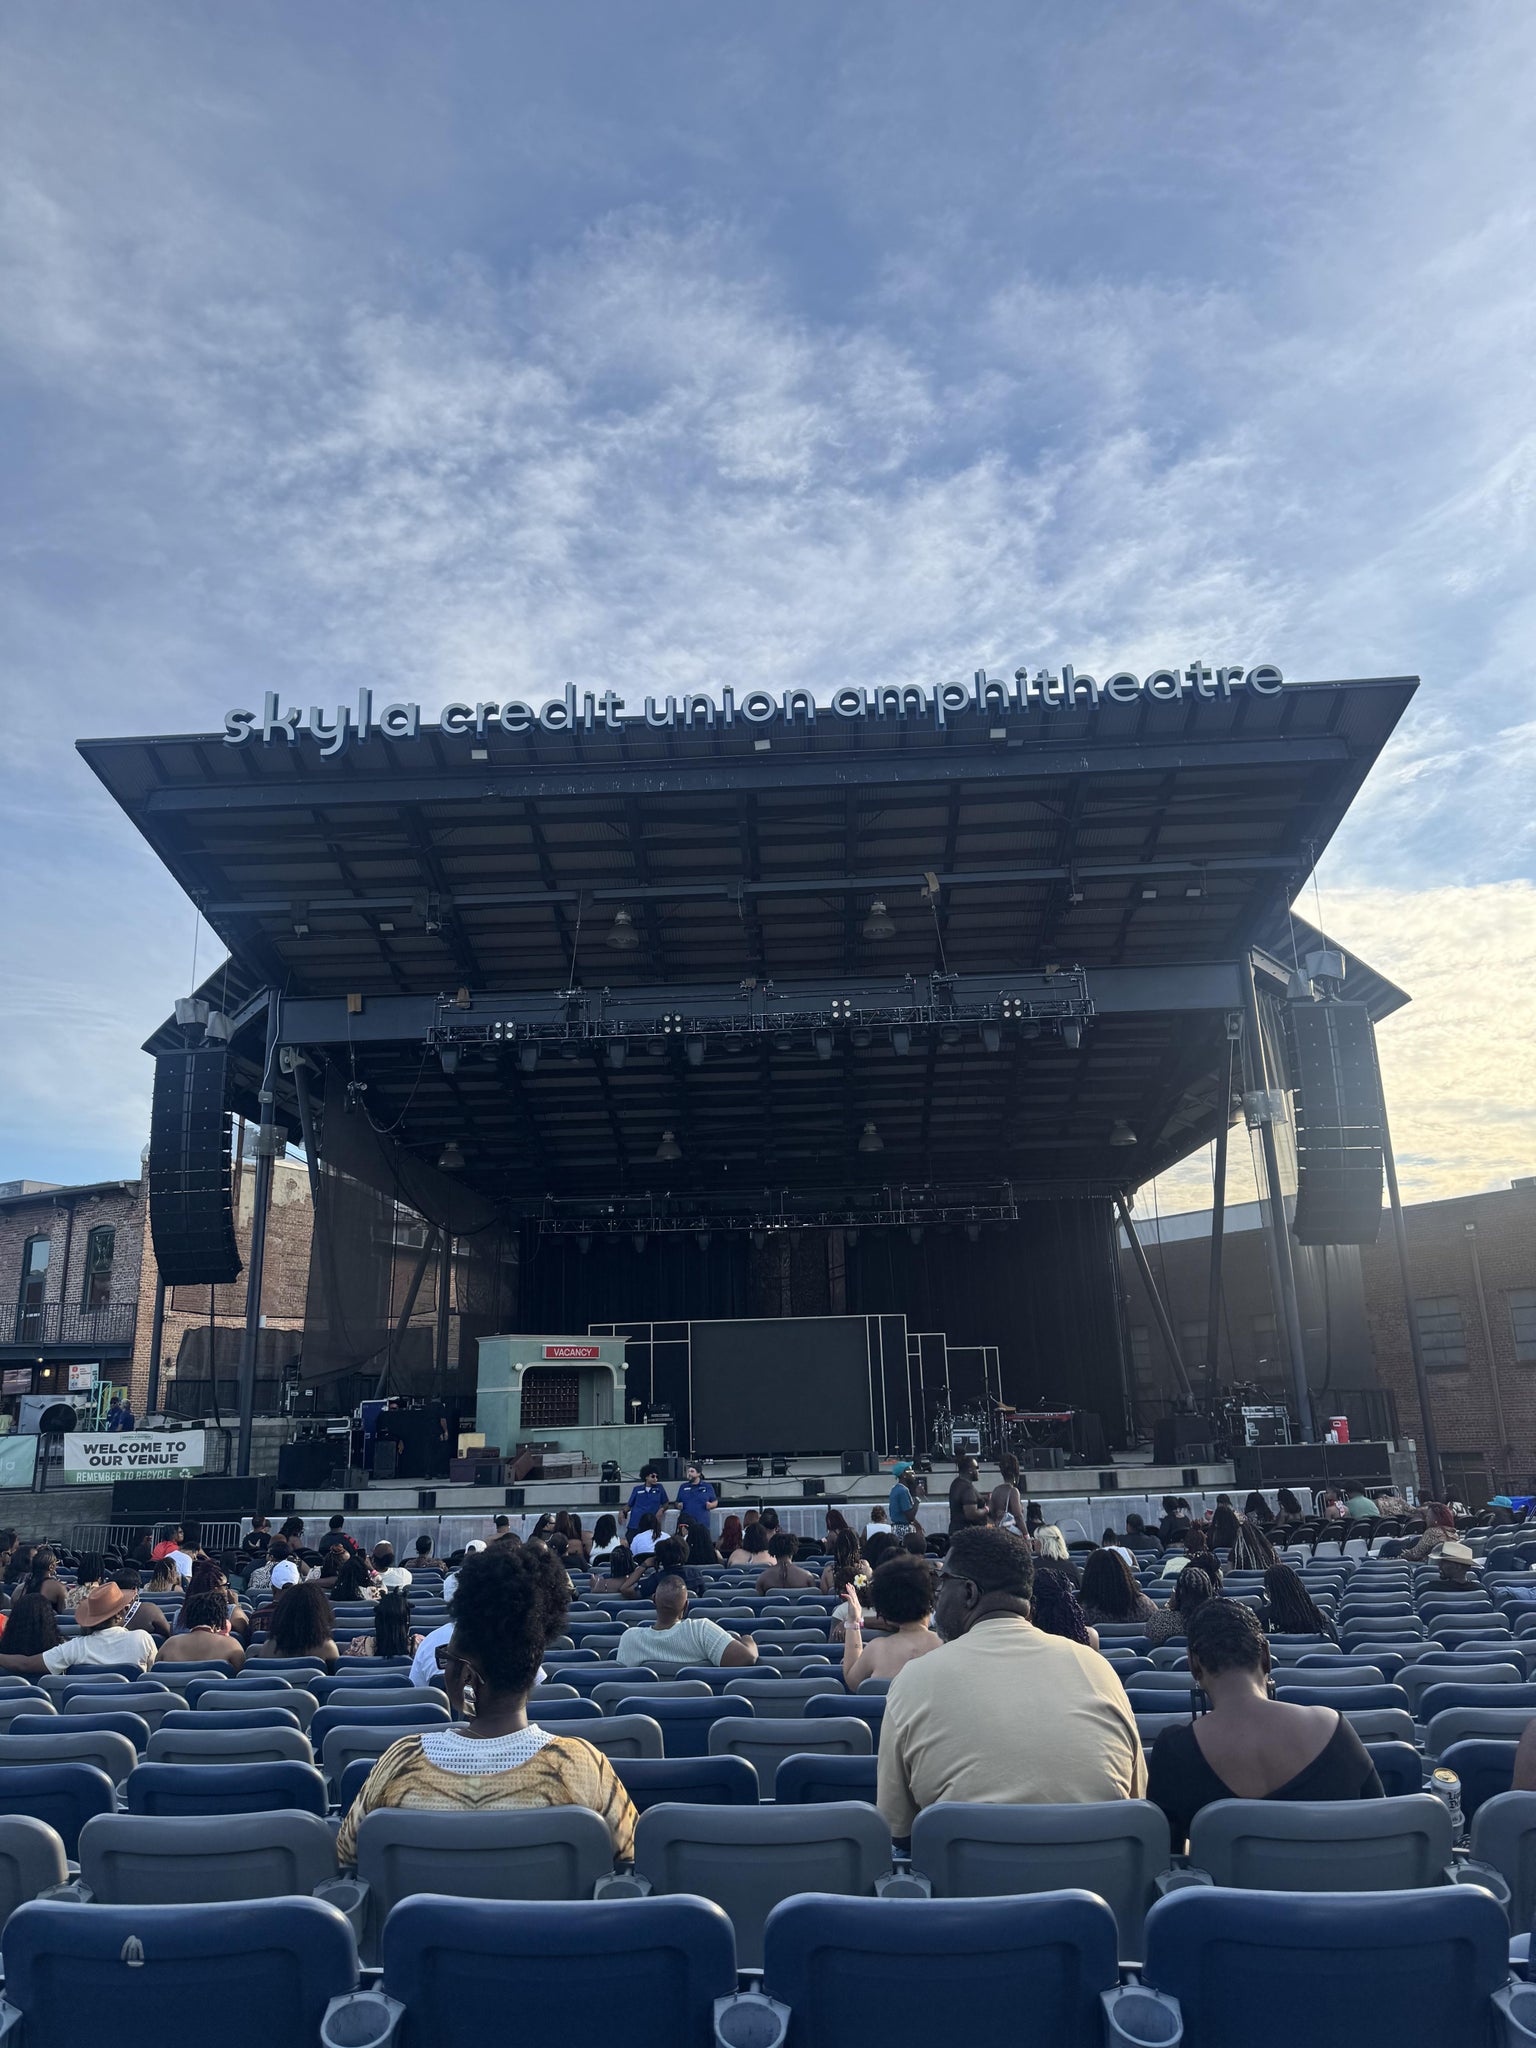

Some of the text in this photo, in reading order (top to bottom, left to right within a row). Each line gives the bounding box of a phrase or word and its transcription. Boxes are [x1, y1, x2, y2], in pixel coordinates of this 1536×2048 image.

[222, 659, 1284, 760] skyla credit union amphitheatre
[553, 1348, 592, 1357] VACANCY
[83, 1441, 187, 1455] WELCOME TO
[89, 1453, 179, 1467] OUR VENUE
[76, 1469, 172, 1483] REMEMBER TO RECYCLE
